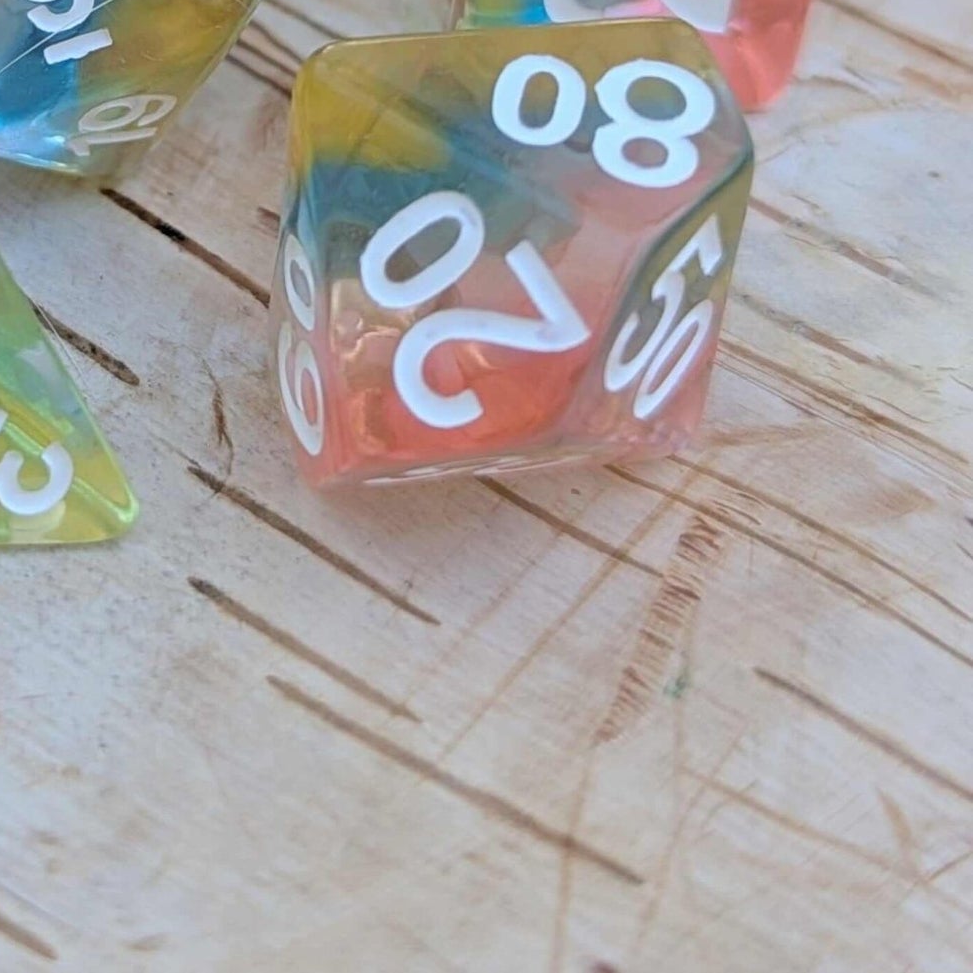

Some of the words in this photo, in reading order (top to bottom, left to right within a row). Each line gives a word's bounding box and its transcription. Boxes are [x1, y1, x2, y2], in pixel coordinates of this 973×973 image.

[491, 54, 716, 188] 80
[360, 191, 591, 429] 20
[604, 213, 722, 419] 50
